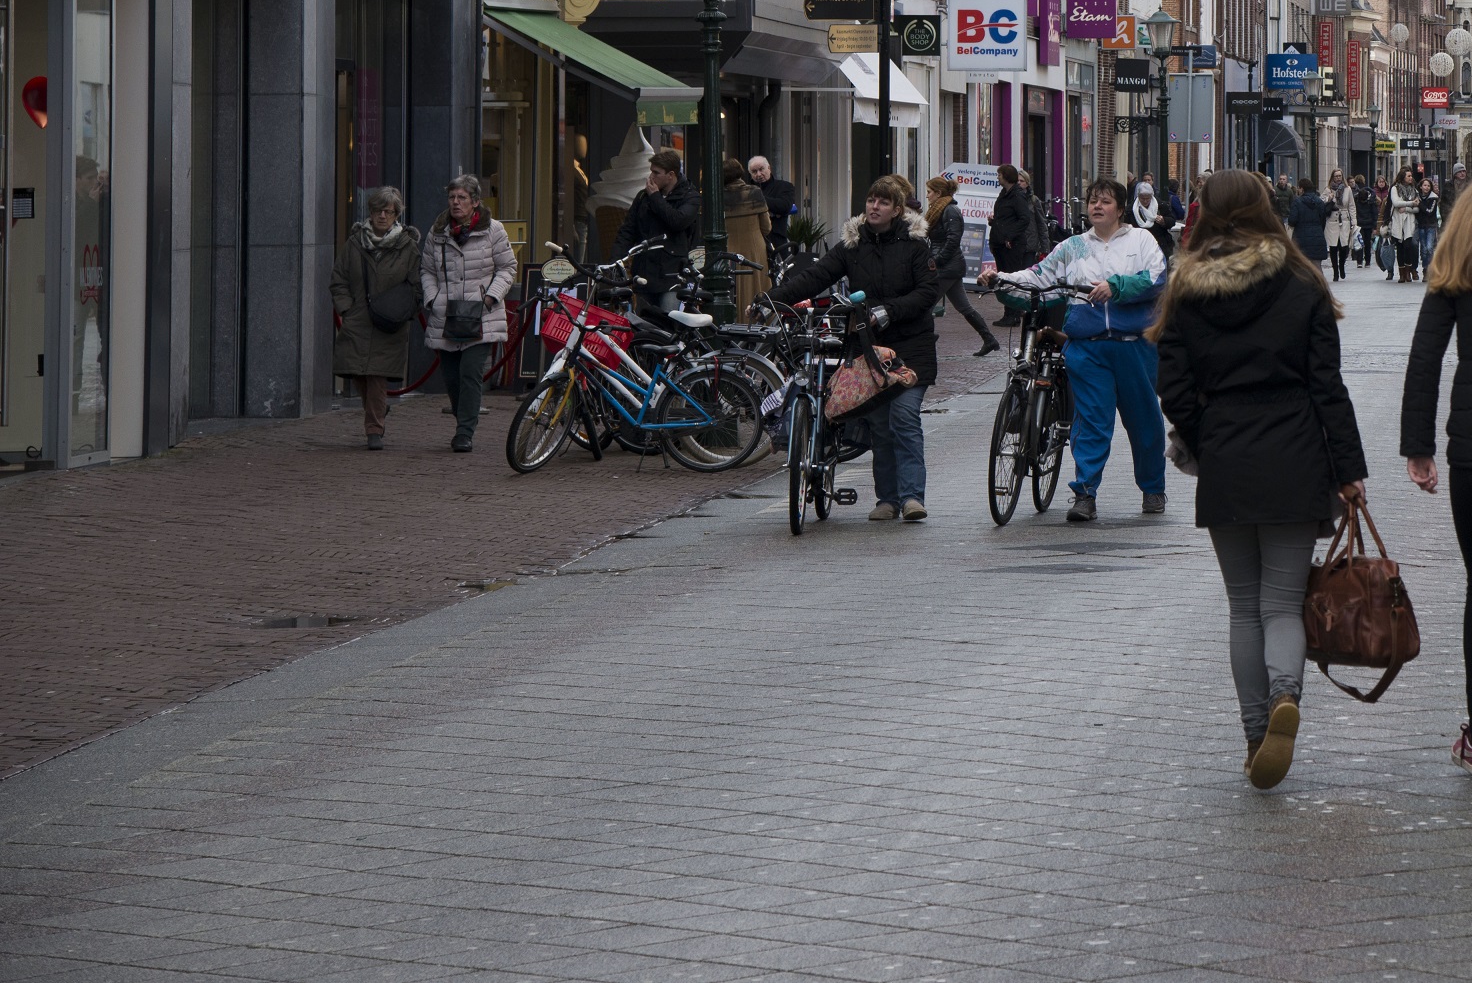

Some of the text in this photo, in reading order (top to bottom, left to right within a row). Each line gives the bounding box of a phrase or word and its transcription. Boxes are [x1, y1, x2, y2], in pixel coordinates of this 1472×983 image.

[1069, 6, 1114, 22] Etam
[957, 8, 1019, 44] BC
[956, 46, 1019, 57] BelCompany
[1116, 76, 1147, 85] MANGO
[964, 198, 994, 209] ALLEEN
